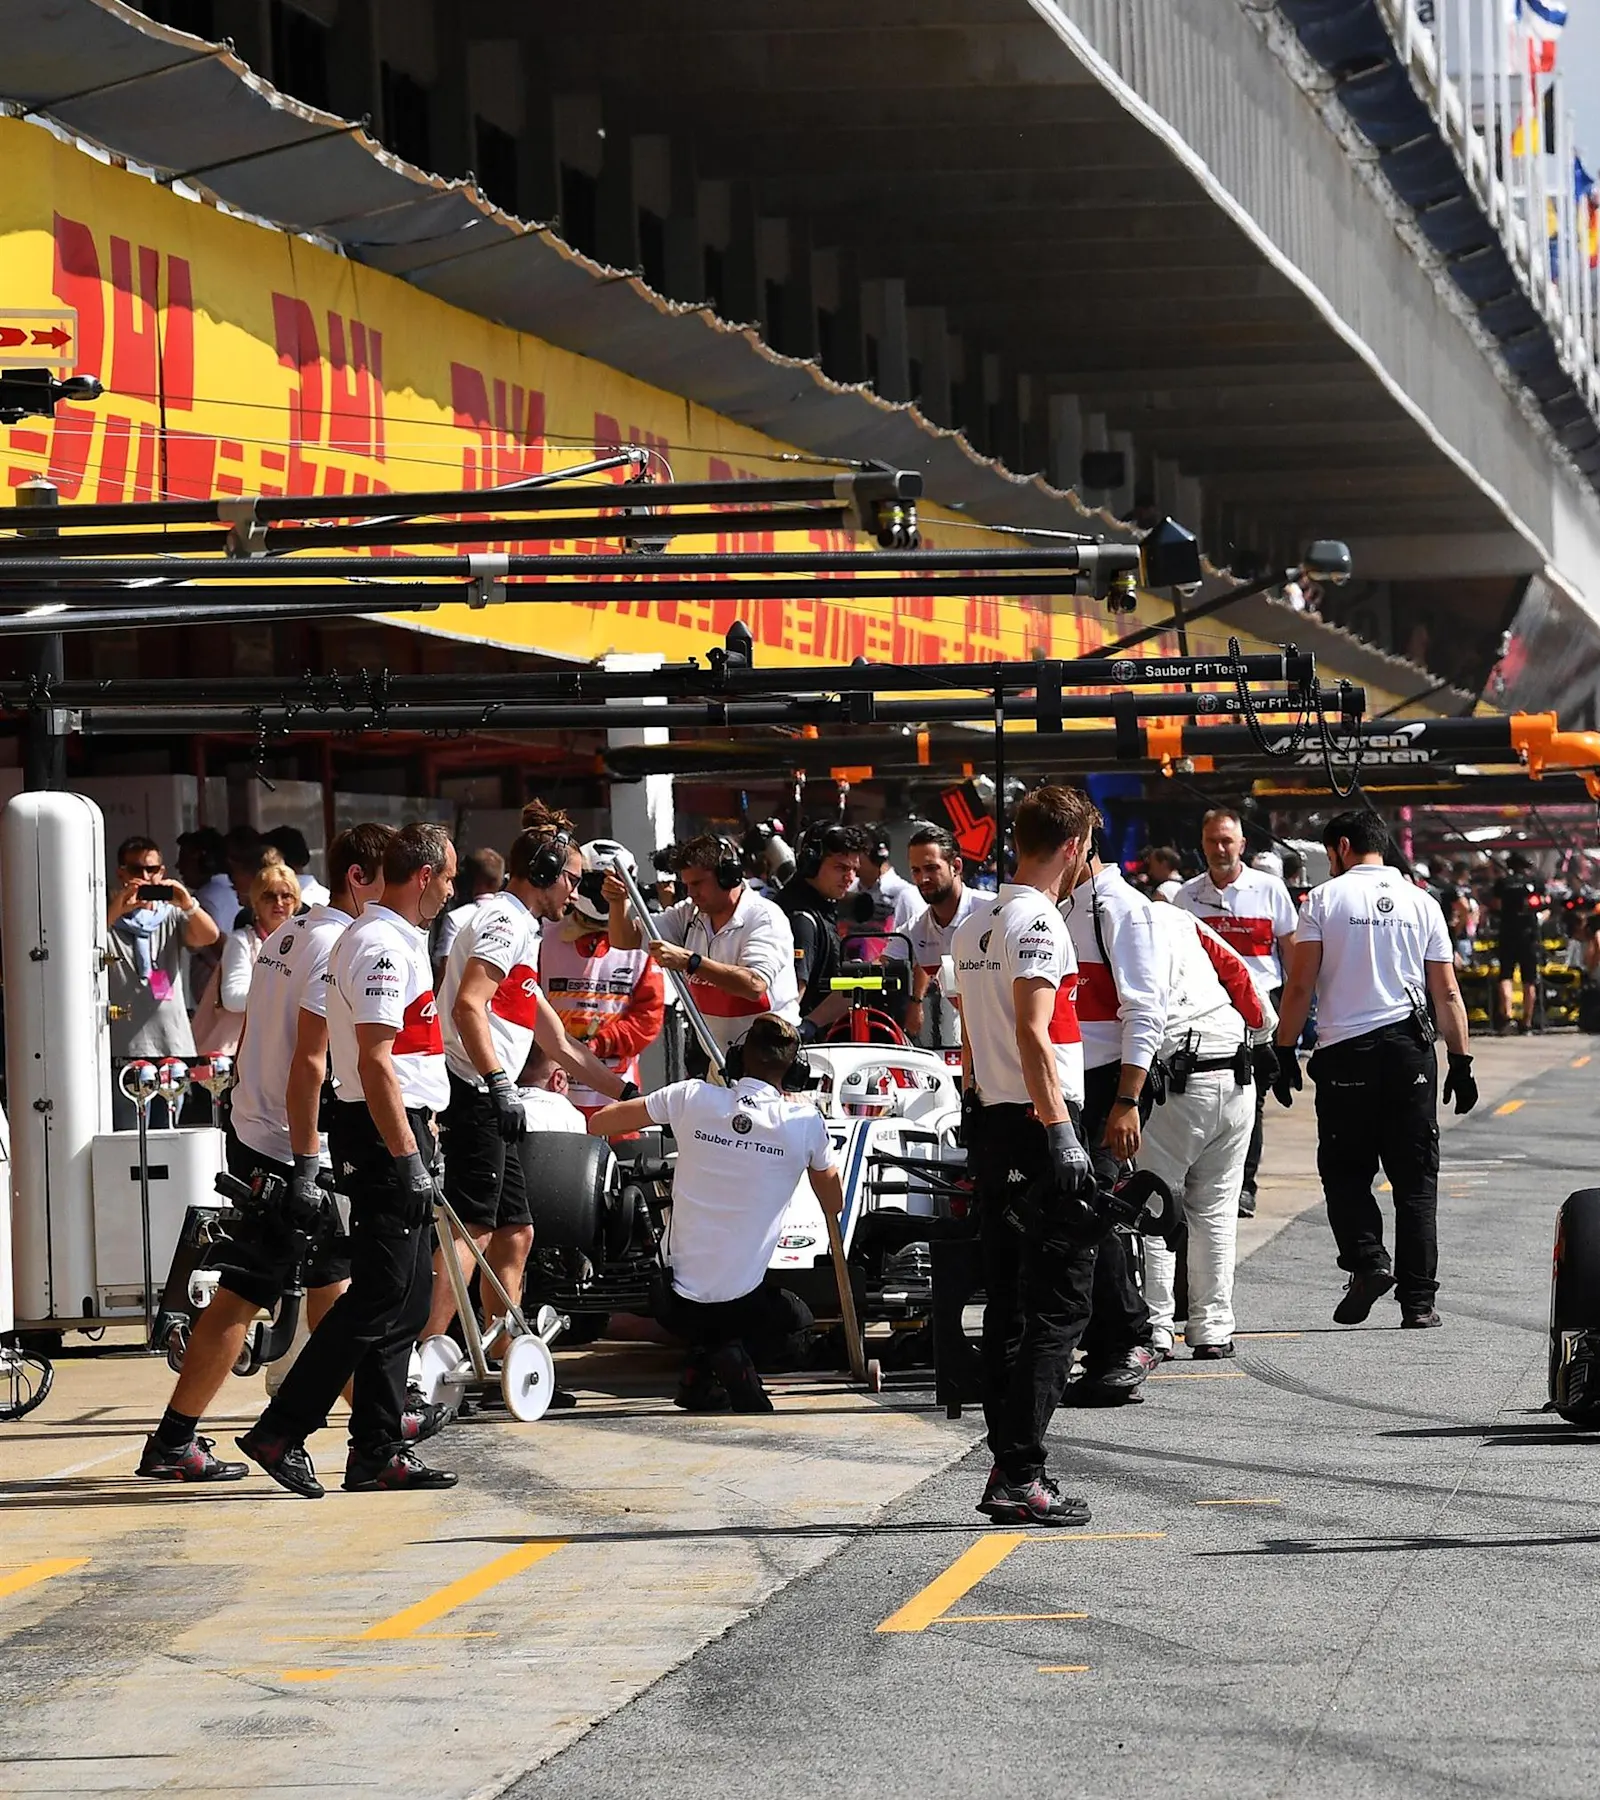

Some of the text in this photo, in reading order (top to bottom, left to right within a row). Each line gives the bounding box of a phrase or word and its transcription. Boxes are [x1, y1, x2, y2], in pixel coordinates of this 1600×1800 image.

[1144, 664, 1192, 678] Sauber
[1213, 662, 1248, 676] Team
[1019, 937, 1054, 947] CARRERA
[694, 1129, 733, 1147] Sauber
[754, 1142, 785, 1157] Team
